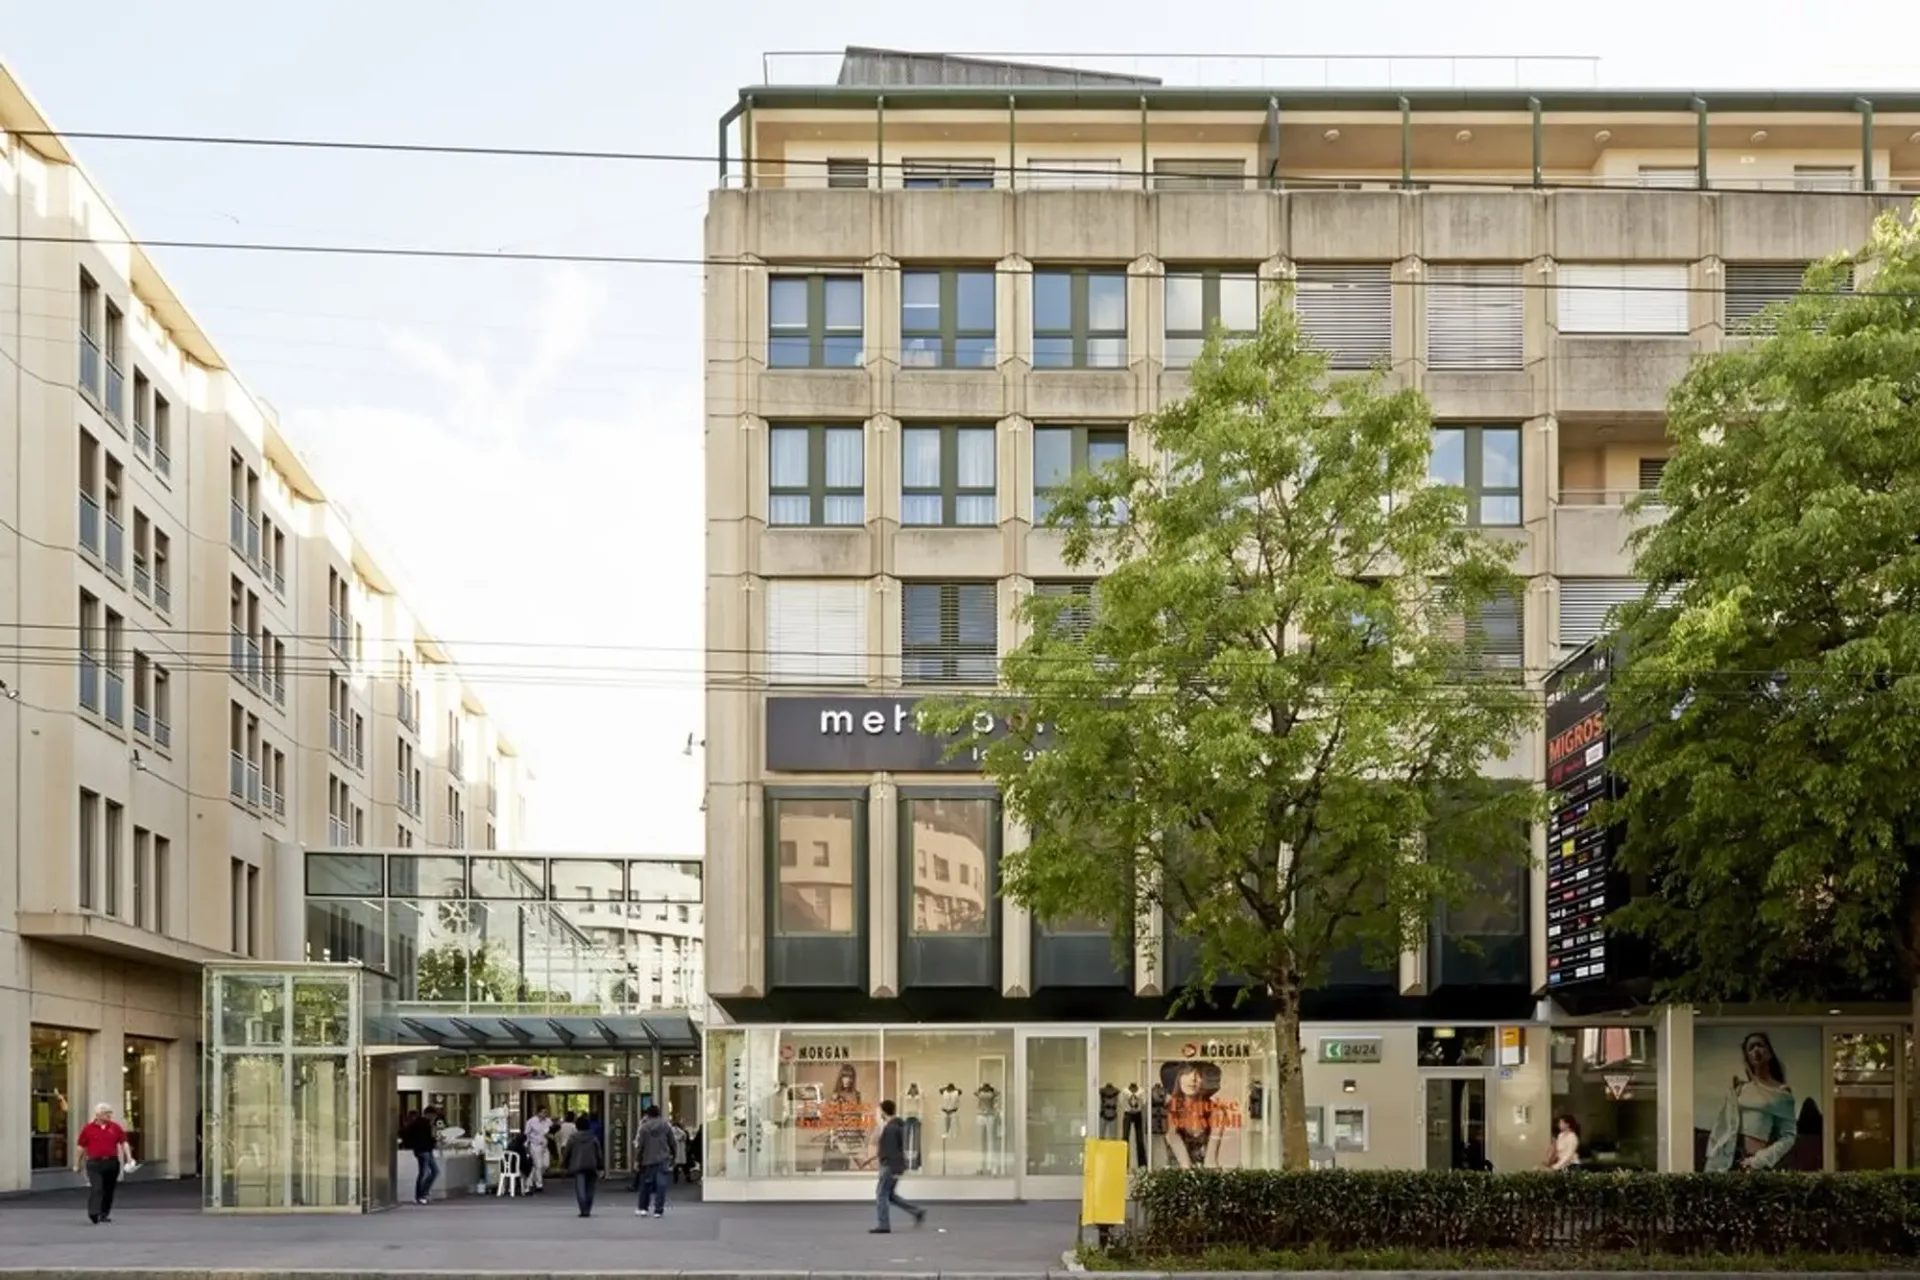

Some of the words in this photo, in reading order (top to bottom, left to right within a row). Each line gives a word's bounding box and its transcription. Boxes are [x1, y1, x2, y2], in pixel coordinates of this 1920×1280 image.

[1549, 712, 1603, 764] MIGROS
[799, 1046, 849, 1059] MORGAN
[1200, 1045, 1250, 1057] MORGAN
[1342, 1044, 1377, 1056] 24/24
